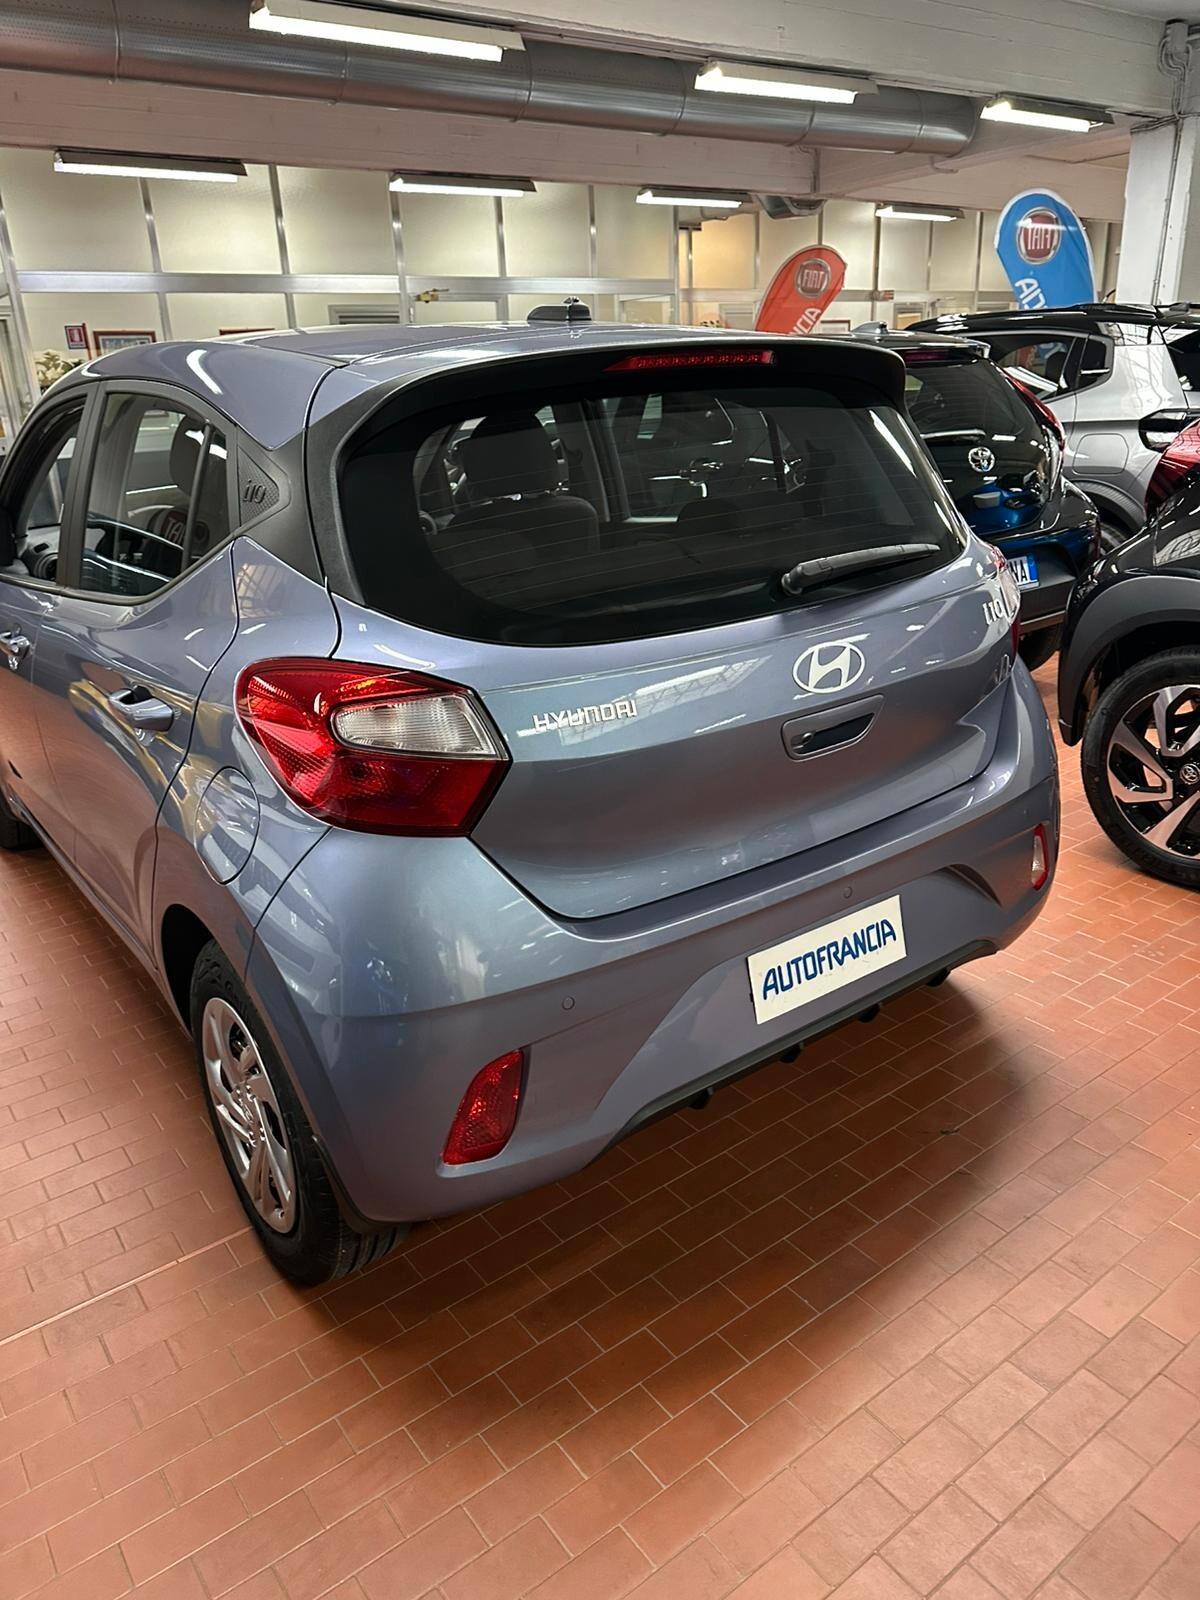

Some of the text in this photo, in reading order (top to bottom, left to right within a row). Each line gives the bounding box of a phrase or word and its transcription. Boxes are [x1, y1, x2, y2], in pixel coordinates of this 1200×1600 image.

[802, 269, 825, 289] FIAT
[532, 699, 638, 732] HYUNDAI
[762, 918, 897, 1001] AUTOFRANCIA
